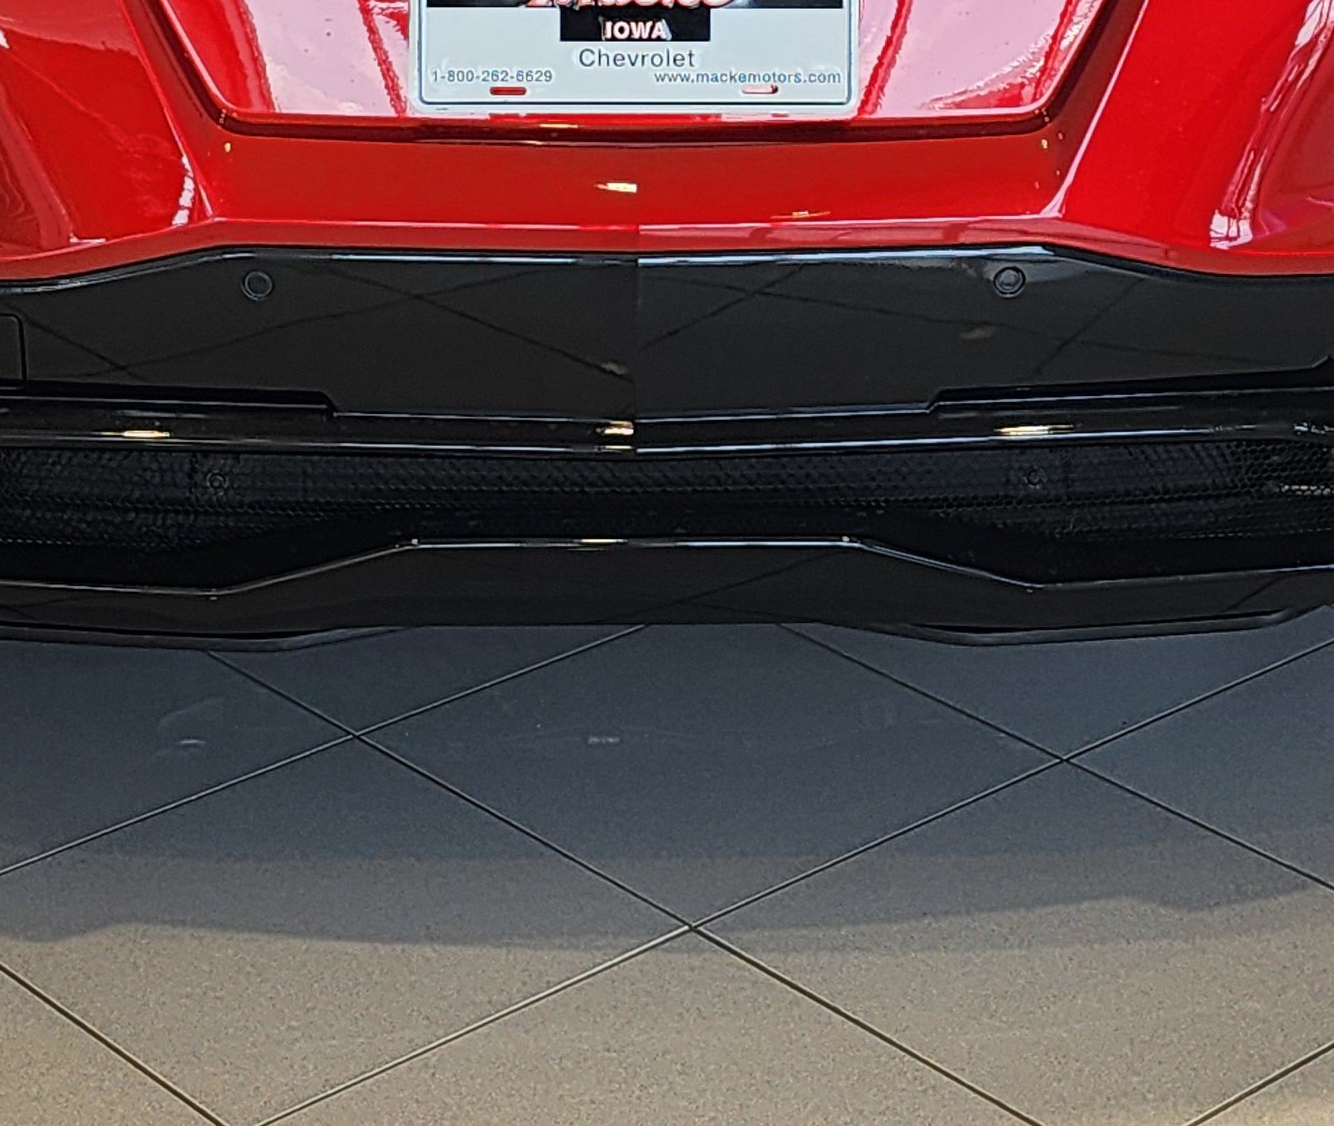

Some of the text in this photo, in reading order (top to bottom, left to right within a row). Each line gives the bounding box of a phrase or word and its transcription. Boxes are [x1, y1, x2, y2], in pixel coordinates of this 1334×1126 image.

[603, 19, 669, 40] IOWA
[578, 48, 696, 68] Chevrolet
[431, 69, 842, 85] 1-800-262-6629 www.mackemotors.com
